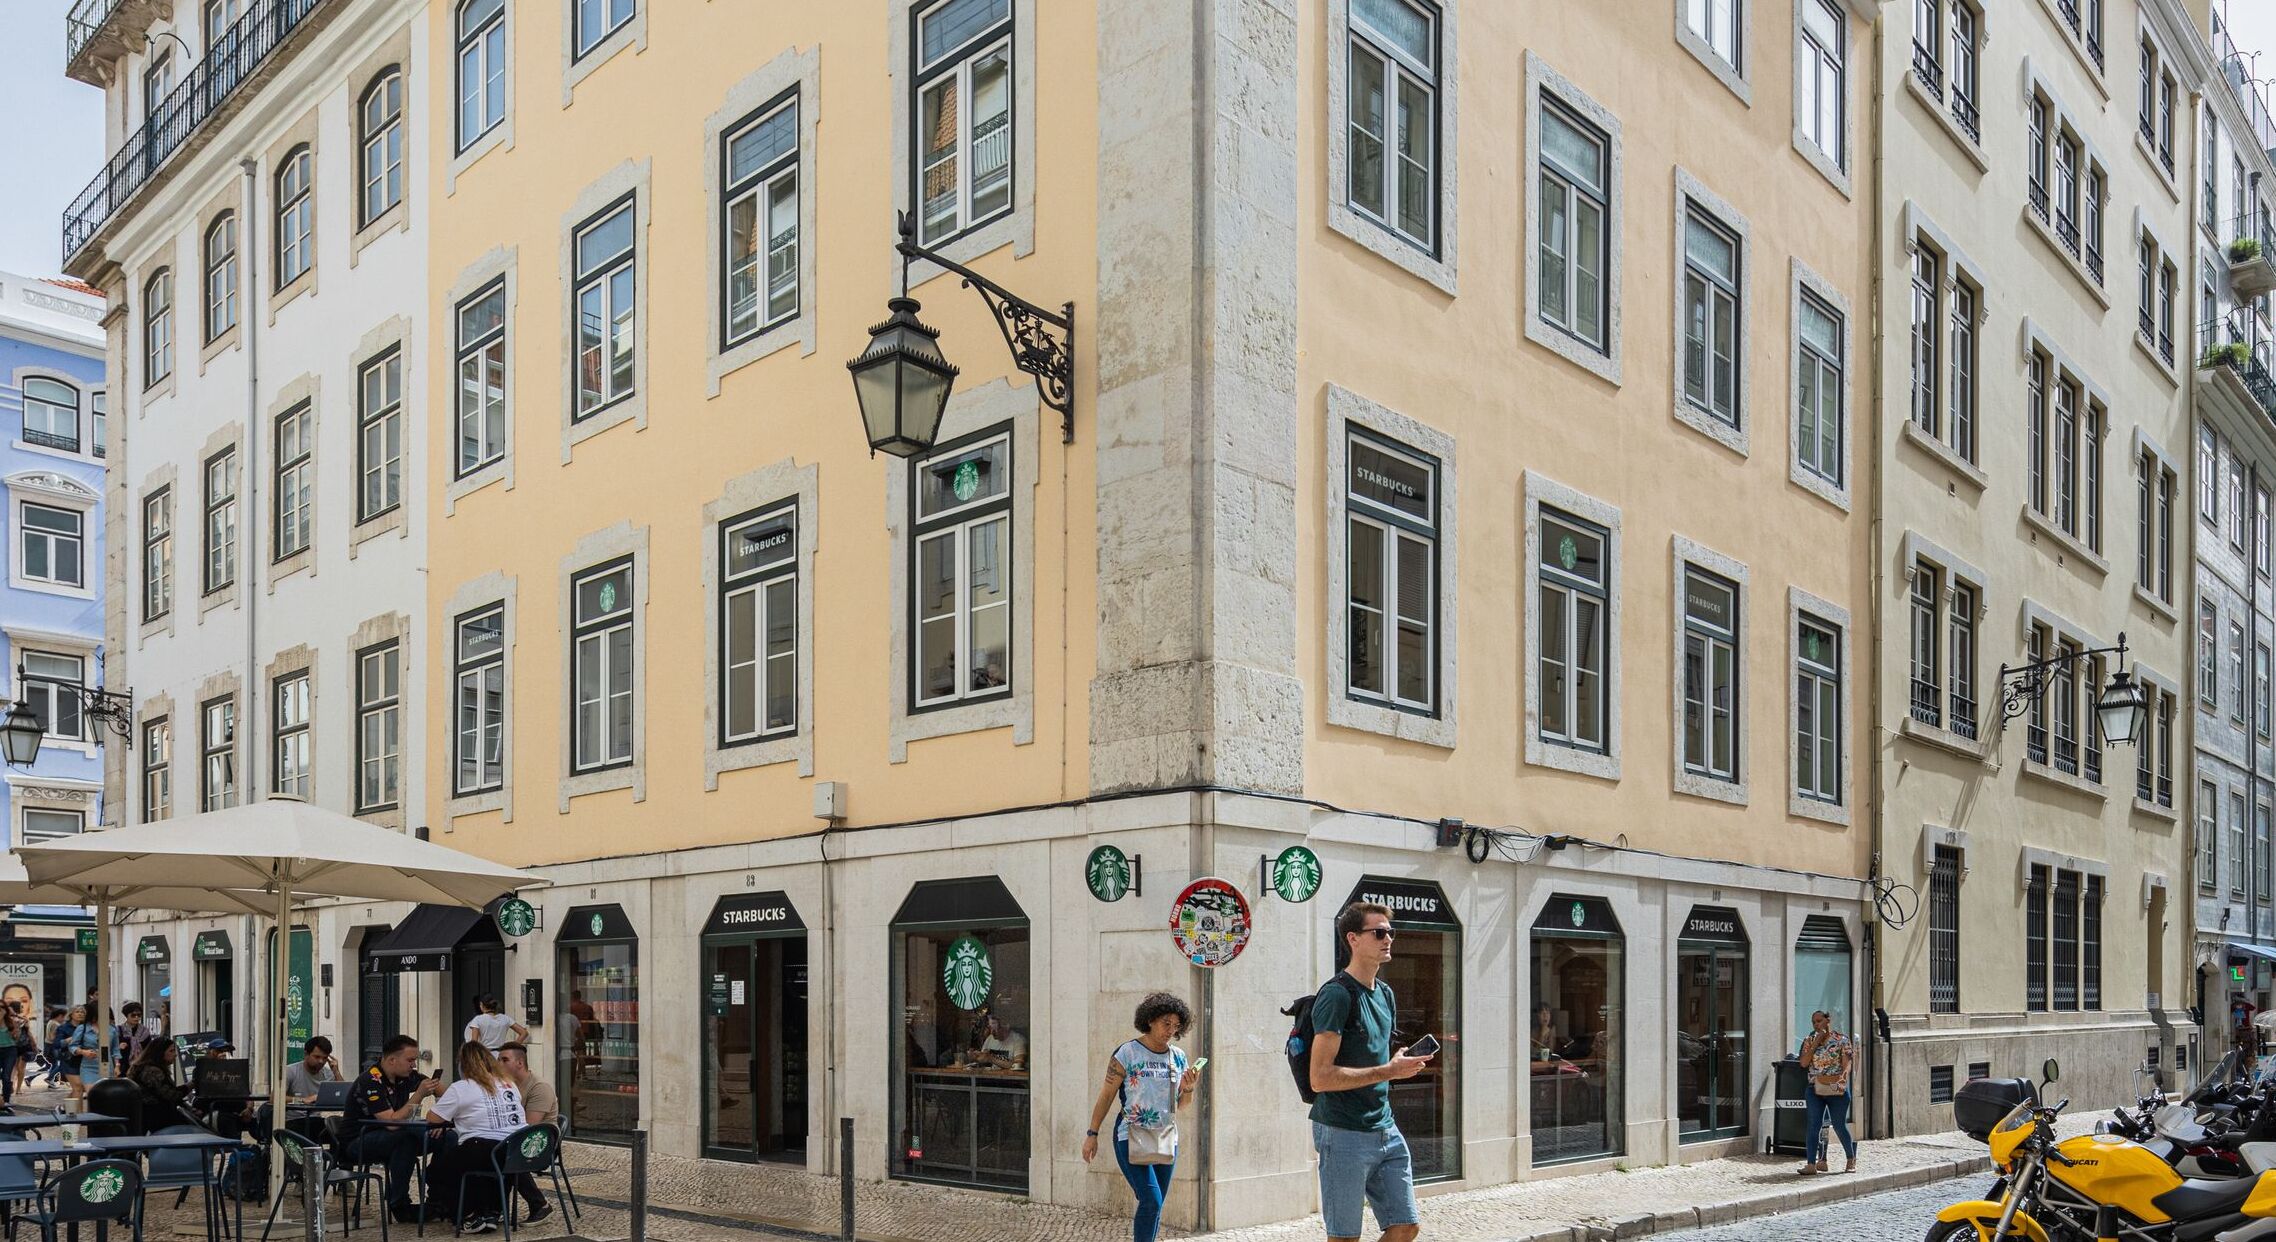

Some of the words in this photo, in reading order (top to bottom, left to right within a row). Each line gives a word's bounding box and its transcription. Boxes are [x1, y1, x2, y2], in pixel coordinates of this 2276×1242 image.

[1357, 466, 1414, 497] STARBUCKS
[739, 533, 787, 557] STARBUCKS
[1689, 593, 1721, 613] STARBUCKS
[1362, 892, 1437, 912] STARBUCKS
[723, 907, 786, 924] STARBUCKS
[1690, 919, 1734, 933] STARBUCKS
[400, 955, 417, 965] ANDO
[0, 965, 38, 974] KIKO
[1146, 1061, 1159, 1069] LOST
